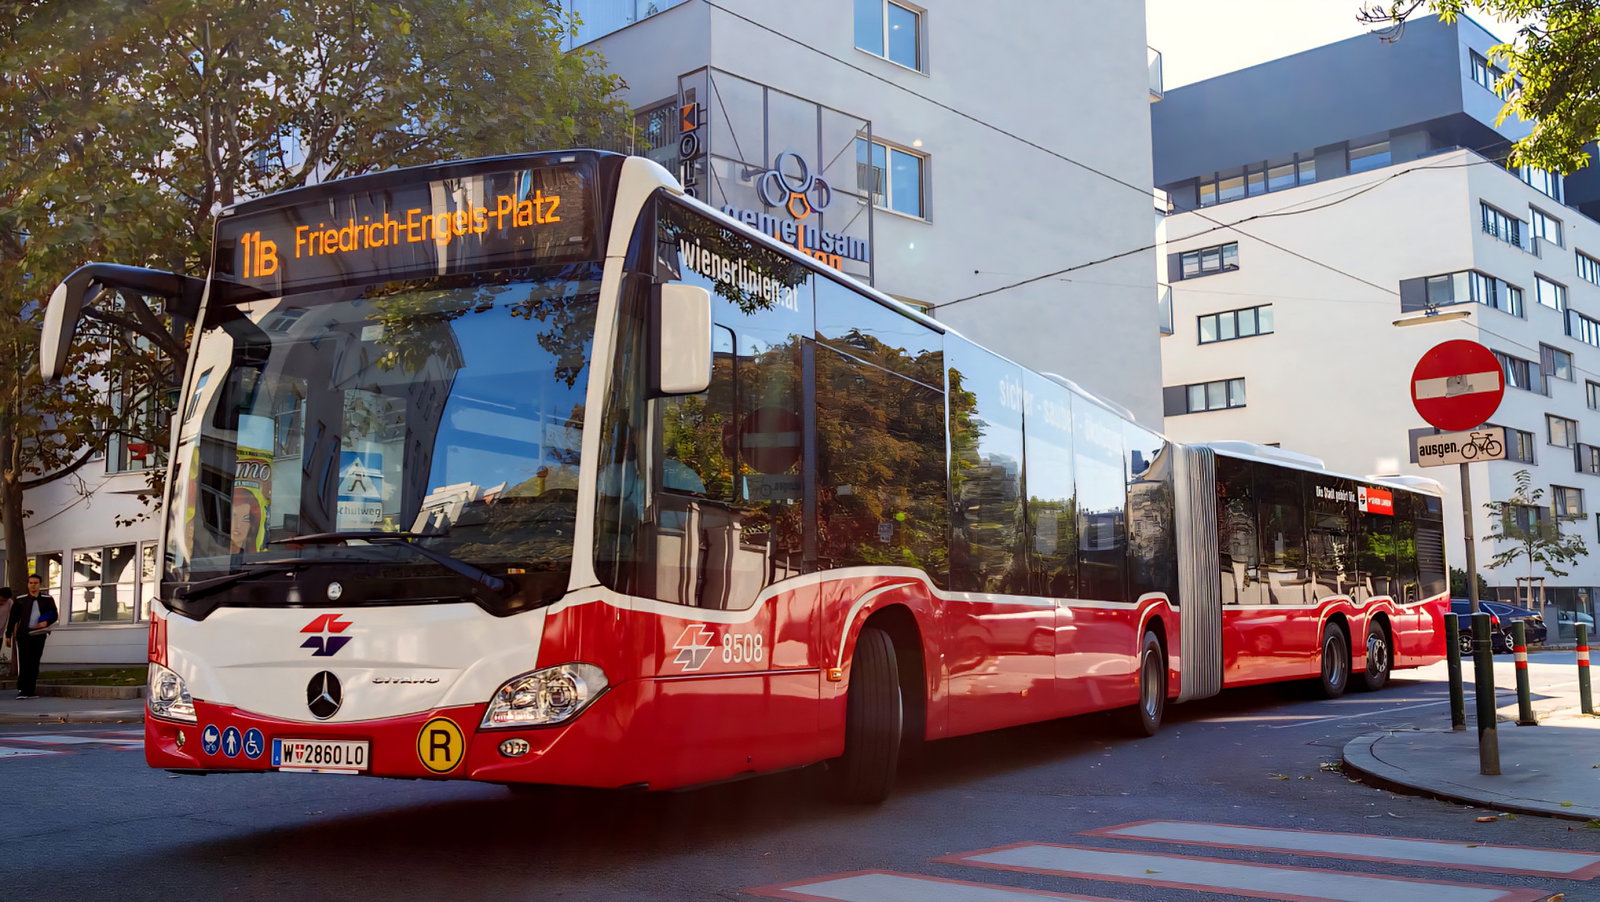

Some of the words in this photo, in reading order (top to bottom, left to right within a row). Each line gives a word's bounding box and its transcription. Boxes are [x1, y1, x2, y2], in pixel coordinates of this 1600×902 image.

[241, 231, 278, 278] 11B
[295, 190, 561, 258] Friedrich-Engels-Platz
[680, 238, 799, 312] wienerlinien.at
[1419, 442, 1460, 458] ausgen.
[338, 506, 381, 518] chulweg
[722, 633, 763, 664] 8508
[283, 743, 294, 763] W
[305, 744, 341, 765] 2860
[345, 745, 364, 765] LO
[429, 729, 451, 762] R
